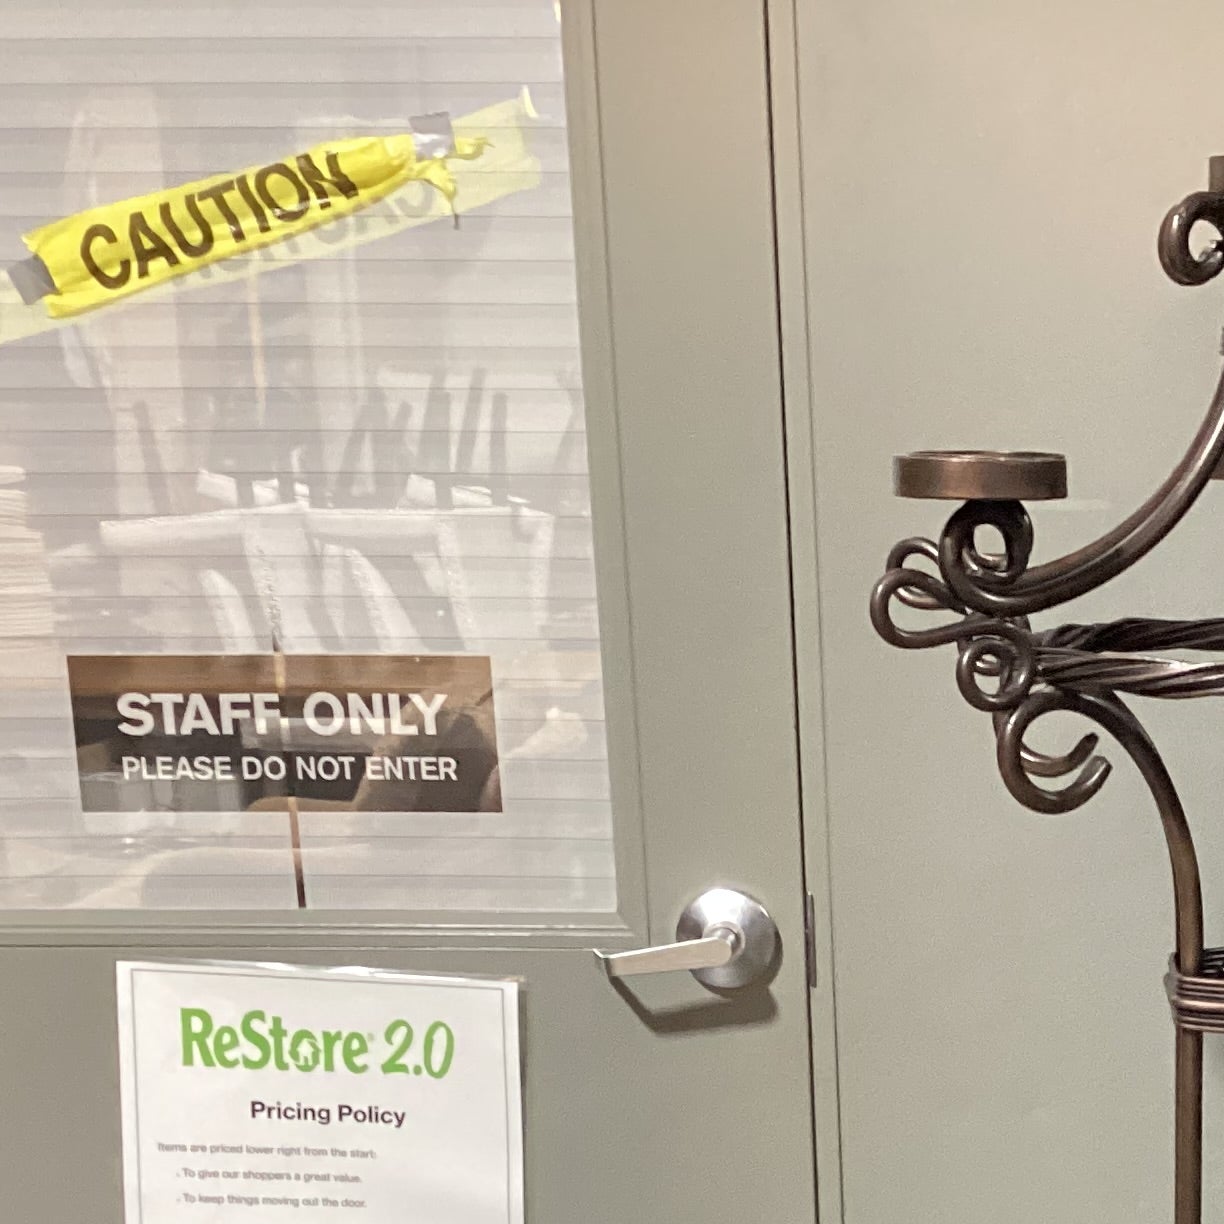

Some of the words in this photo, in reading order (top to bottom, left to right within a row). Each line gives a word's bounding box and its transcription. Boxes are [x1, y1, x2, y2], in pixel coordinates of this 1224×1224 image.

[80, 151, 359, 289] CAUTION
[116, 691, 280, 737] STAFF
[303, 691, 448, 737] ONLY
[122, 755, 236, 781] PLEASE
[242, 756, 287, 781] DO
[296, 756, 355, 781] NOT
[366, 756, 458, 781] ENTER
[181, 1008, 368, 1073] ReStore
[381, 1018, 454, 1079] 2.0
[250, 1100, 331, 1125] Pricing
[337, 1104, 406, 1128] Policy
